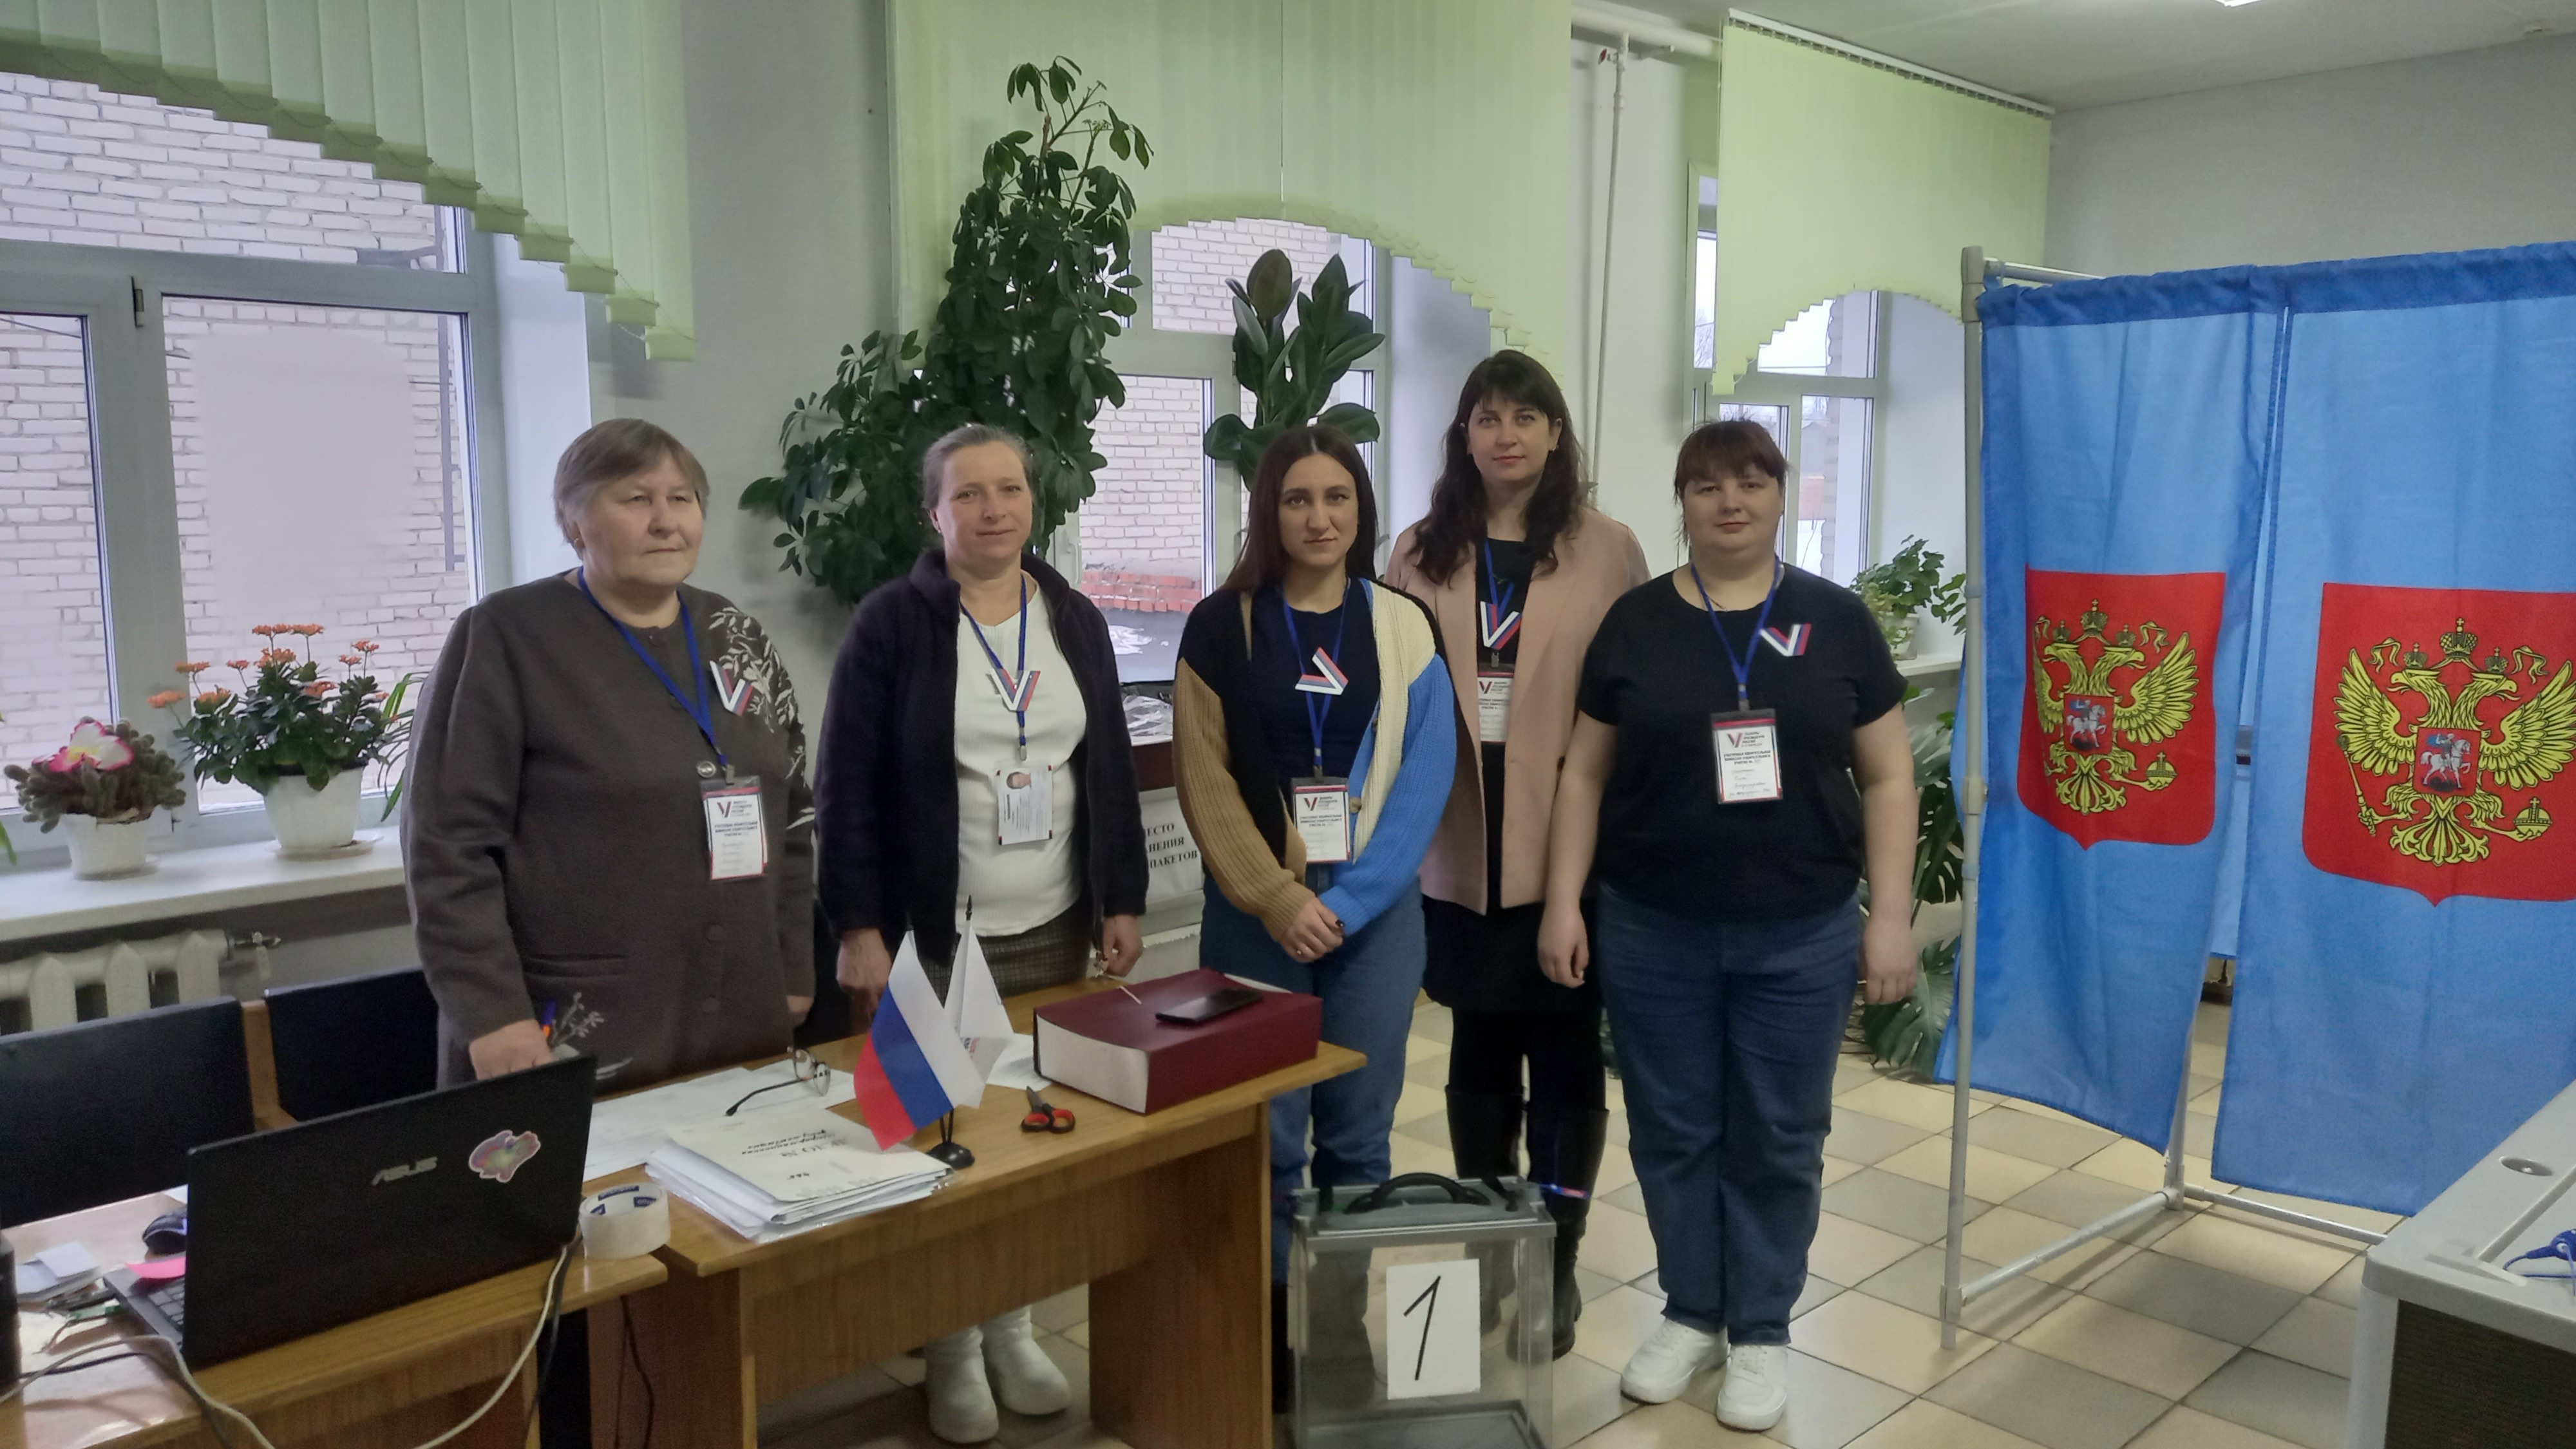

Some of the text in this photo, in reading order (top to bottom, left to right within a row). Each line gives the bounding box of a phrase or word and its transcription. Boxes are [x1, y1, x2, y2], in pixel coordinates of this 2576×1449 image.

[1147, 822, 1175, 837] ЕСТО
[1149, 836, 1184, 853] НЕНИЯ
[1150, 850, 1197, 869] ПАКЕТОВ
[1403, 1274, 1441, 1381] 1
